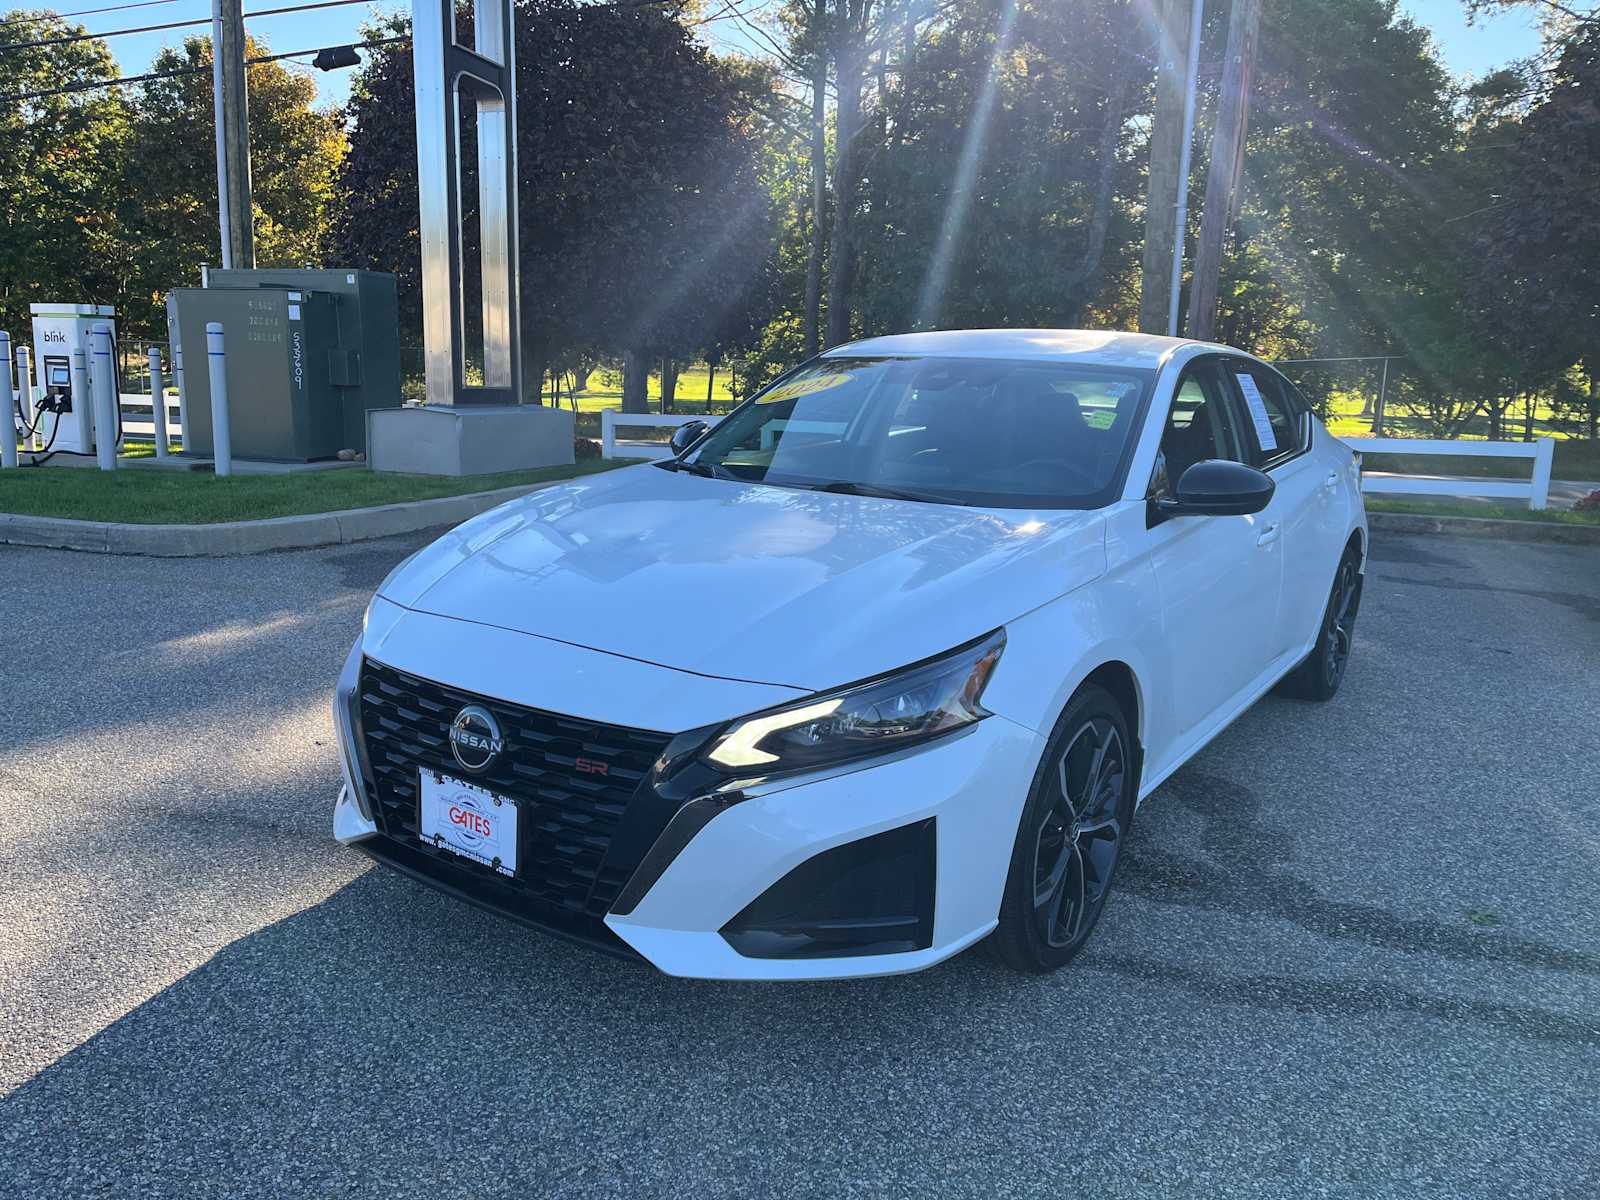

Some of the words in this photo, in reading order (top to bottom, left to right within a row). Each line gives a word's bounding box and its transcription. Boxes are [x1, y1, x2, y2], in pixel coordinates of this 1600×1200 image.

[44, 331, 65, 342] blink
[449, 727, 502, 752] NISSAN
[576, 757, 608, 776] SR
[449, 806, 491, 836] GATES
